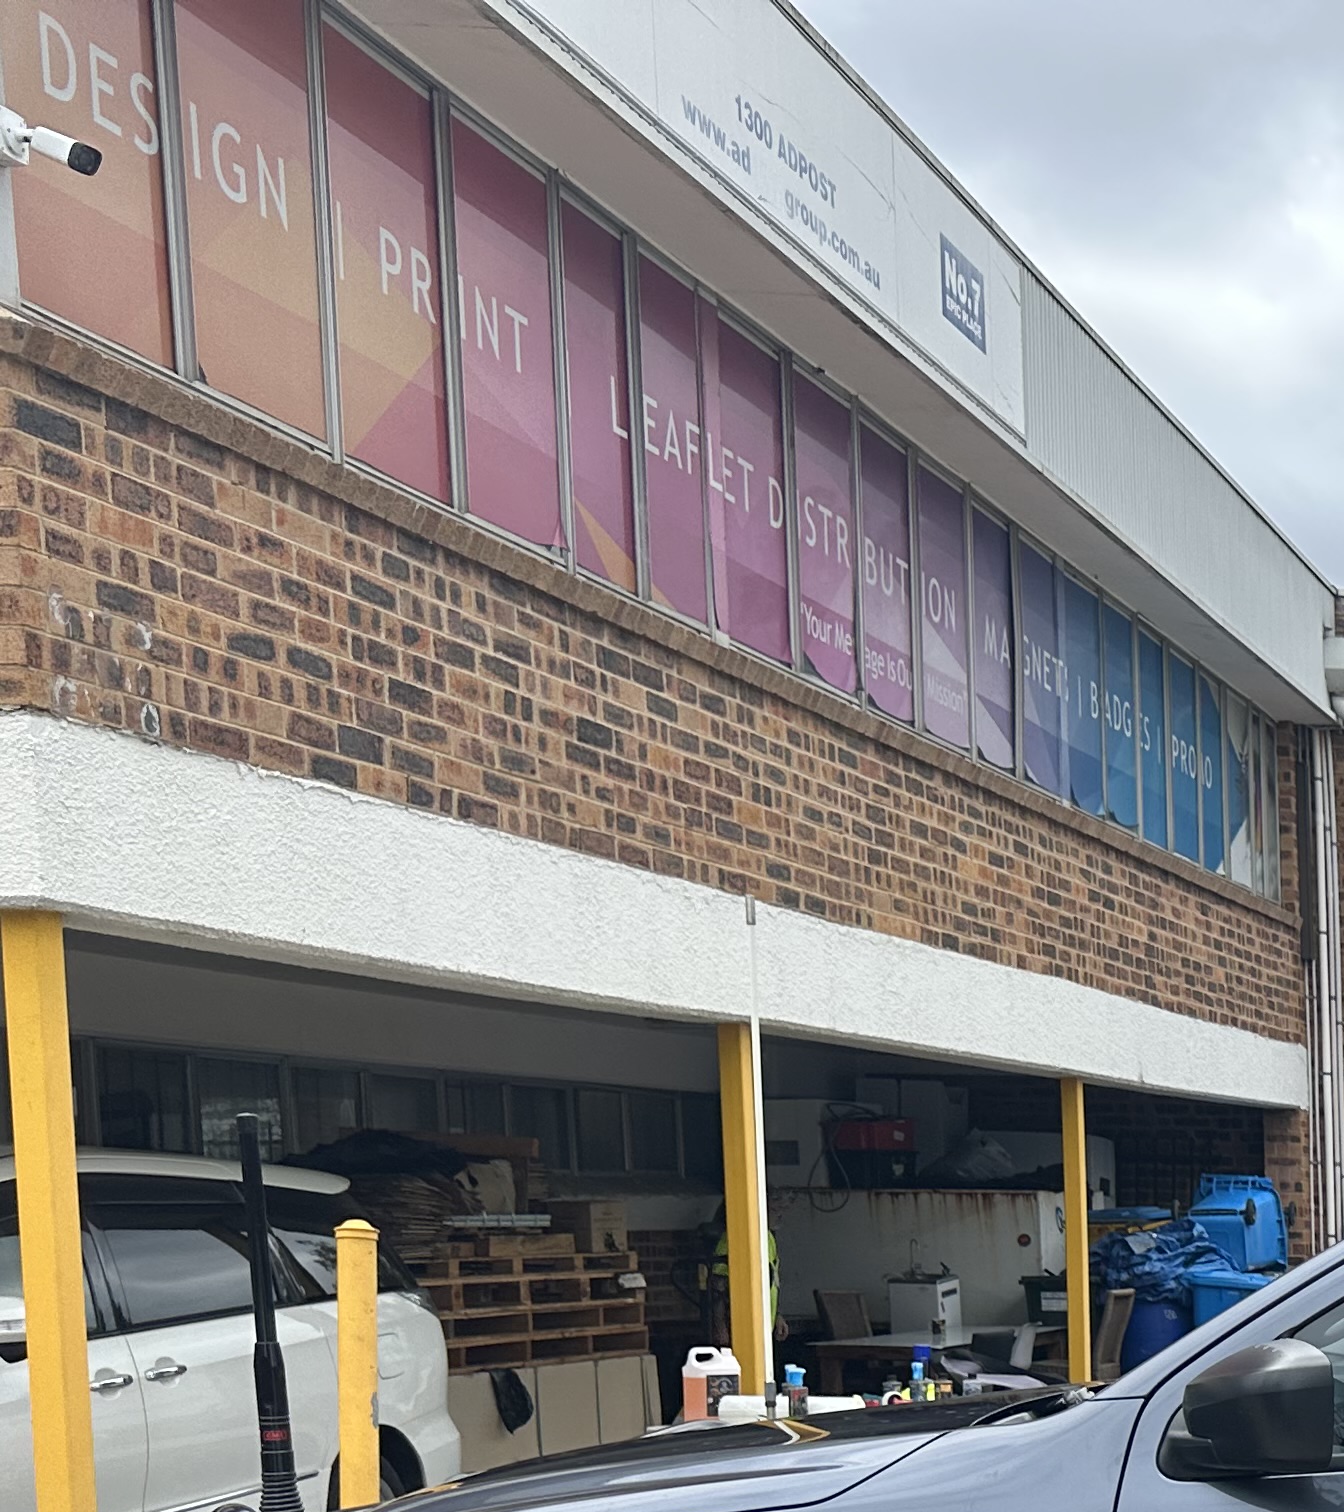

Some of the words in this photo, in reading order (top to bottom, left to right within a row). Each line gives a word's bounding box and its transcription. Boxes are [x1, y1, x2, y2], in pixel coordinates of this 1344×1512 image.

[734, 93, 773, 151] 1300
[777, 132, 837, 209] ADPOST
[944, 249, 981, 320] No.7
[946, 294, 962, 320] EPIC
[38, 9, 289, 233] DESIGN
[378, 225, 529, 374] PRINT
[610, 374, 755, 514] LEAFLET
[767, 475, 957, 633] DISTRIBUTION
[834, 620, 885, 680] Meage
[887, 652, 897, 683] Is
[897, 658, 913, 692] Ou
